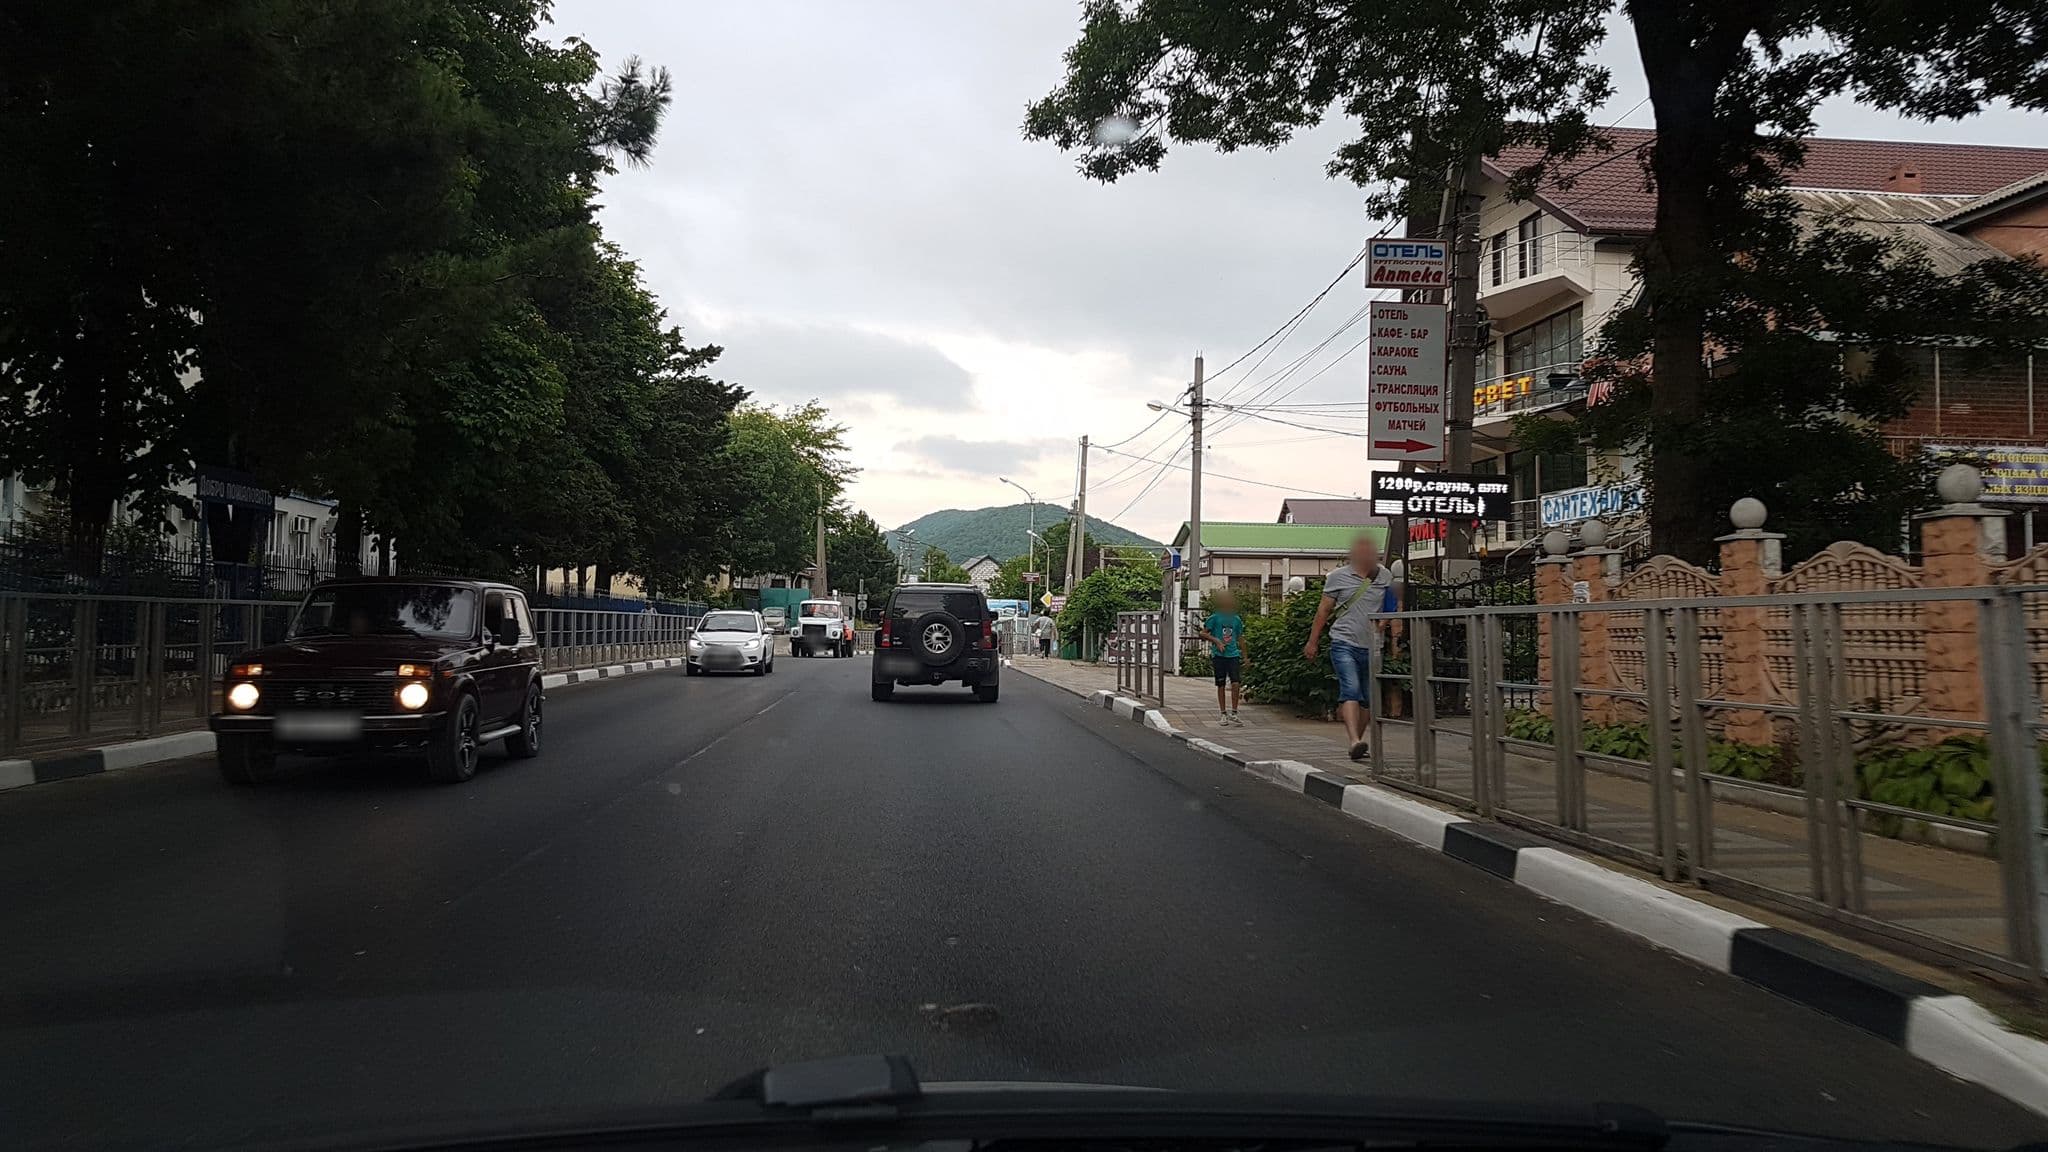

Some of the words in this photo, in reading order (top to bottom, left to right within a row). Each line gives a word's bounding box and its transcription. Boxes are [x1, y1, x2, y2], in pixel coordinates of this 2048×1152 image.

[1374, 244, 1443, 258] ОТЕЛЬ
[1374, 265, 1444, 283] Аптека
[1378, 309, 1408, 320] ОТЕЛЬ
[1377, 327, 1403, 338] КАФЕ
[1410, 328, 1429, 339] БАР
[1376, 346, 1419, 358] КАРАОКЕ
[1376, 365, 1407, 376] САУНА
[1376, 383, 1439, 397] ТРАНСЛЯЦИЯ
[1473, 376, 1534, 406] СВЕТ
[1375, 401, 1440, 414] ФУТБОЛЬНЫХ
[1388, 418, 1426, 431] МАТЧЕЙ
[226, 482, 273, 505] ПОЖАЛОВАТЬ
[1543, 488, 1640, 523] САНТЕХНИА
